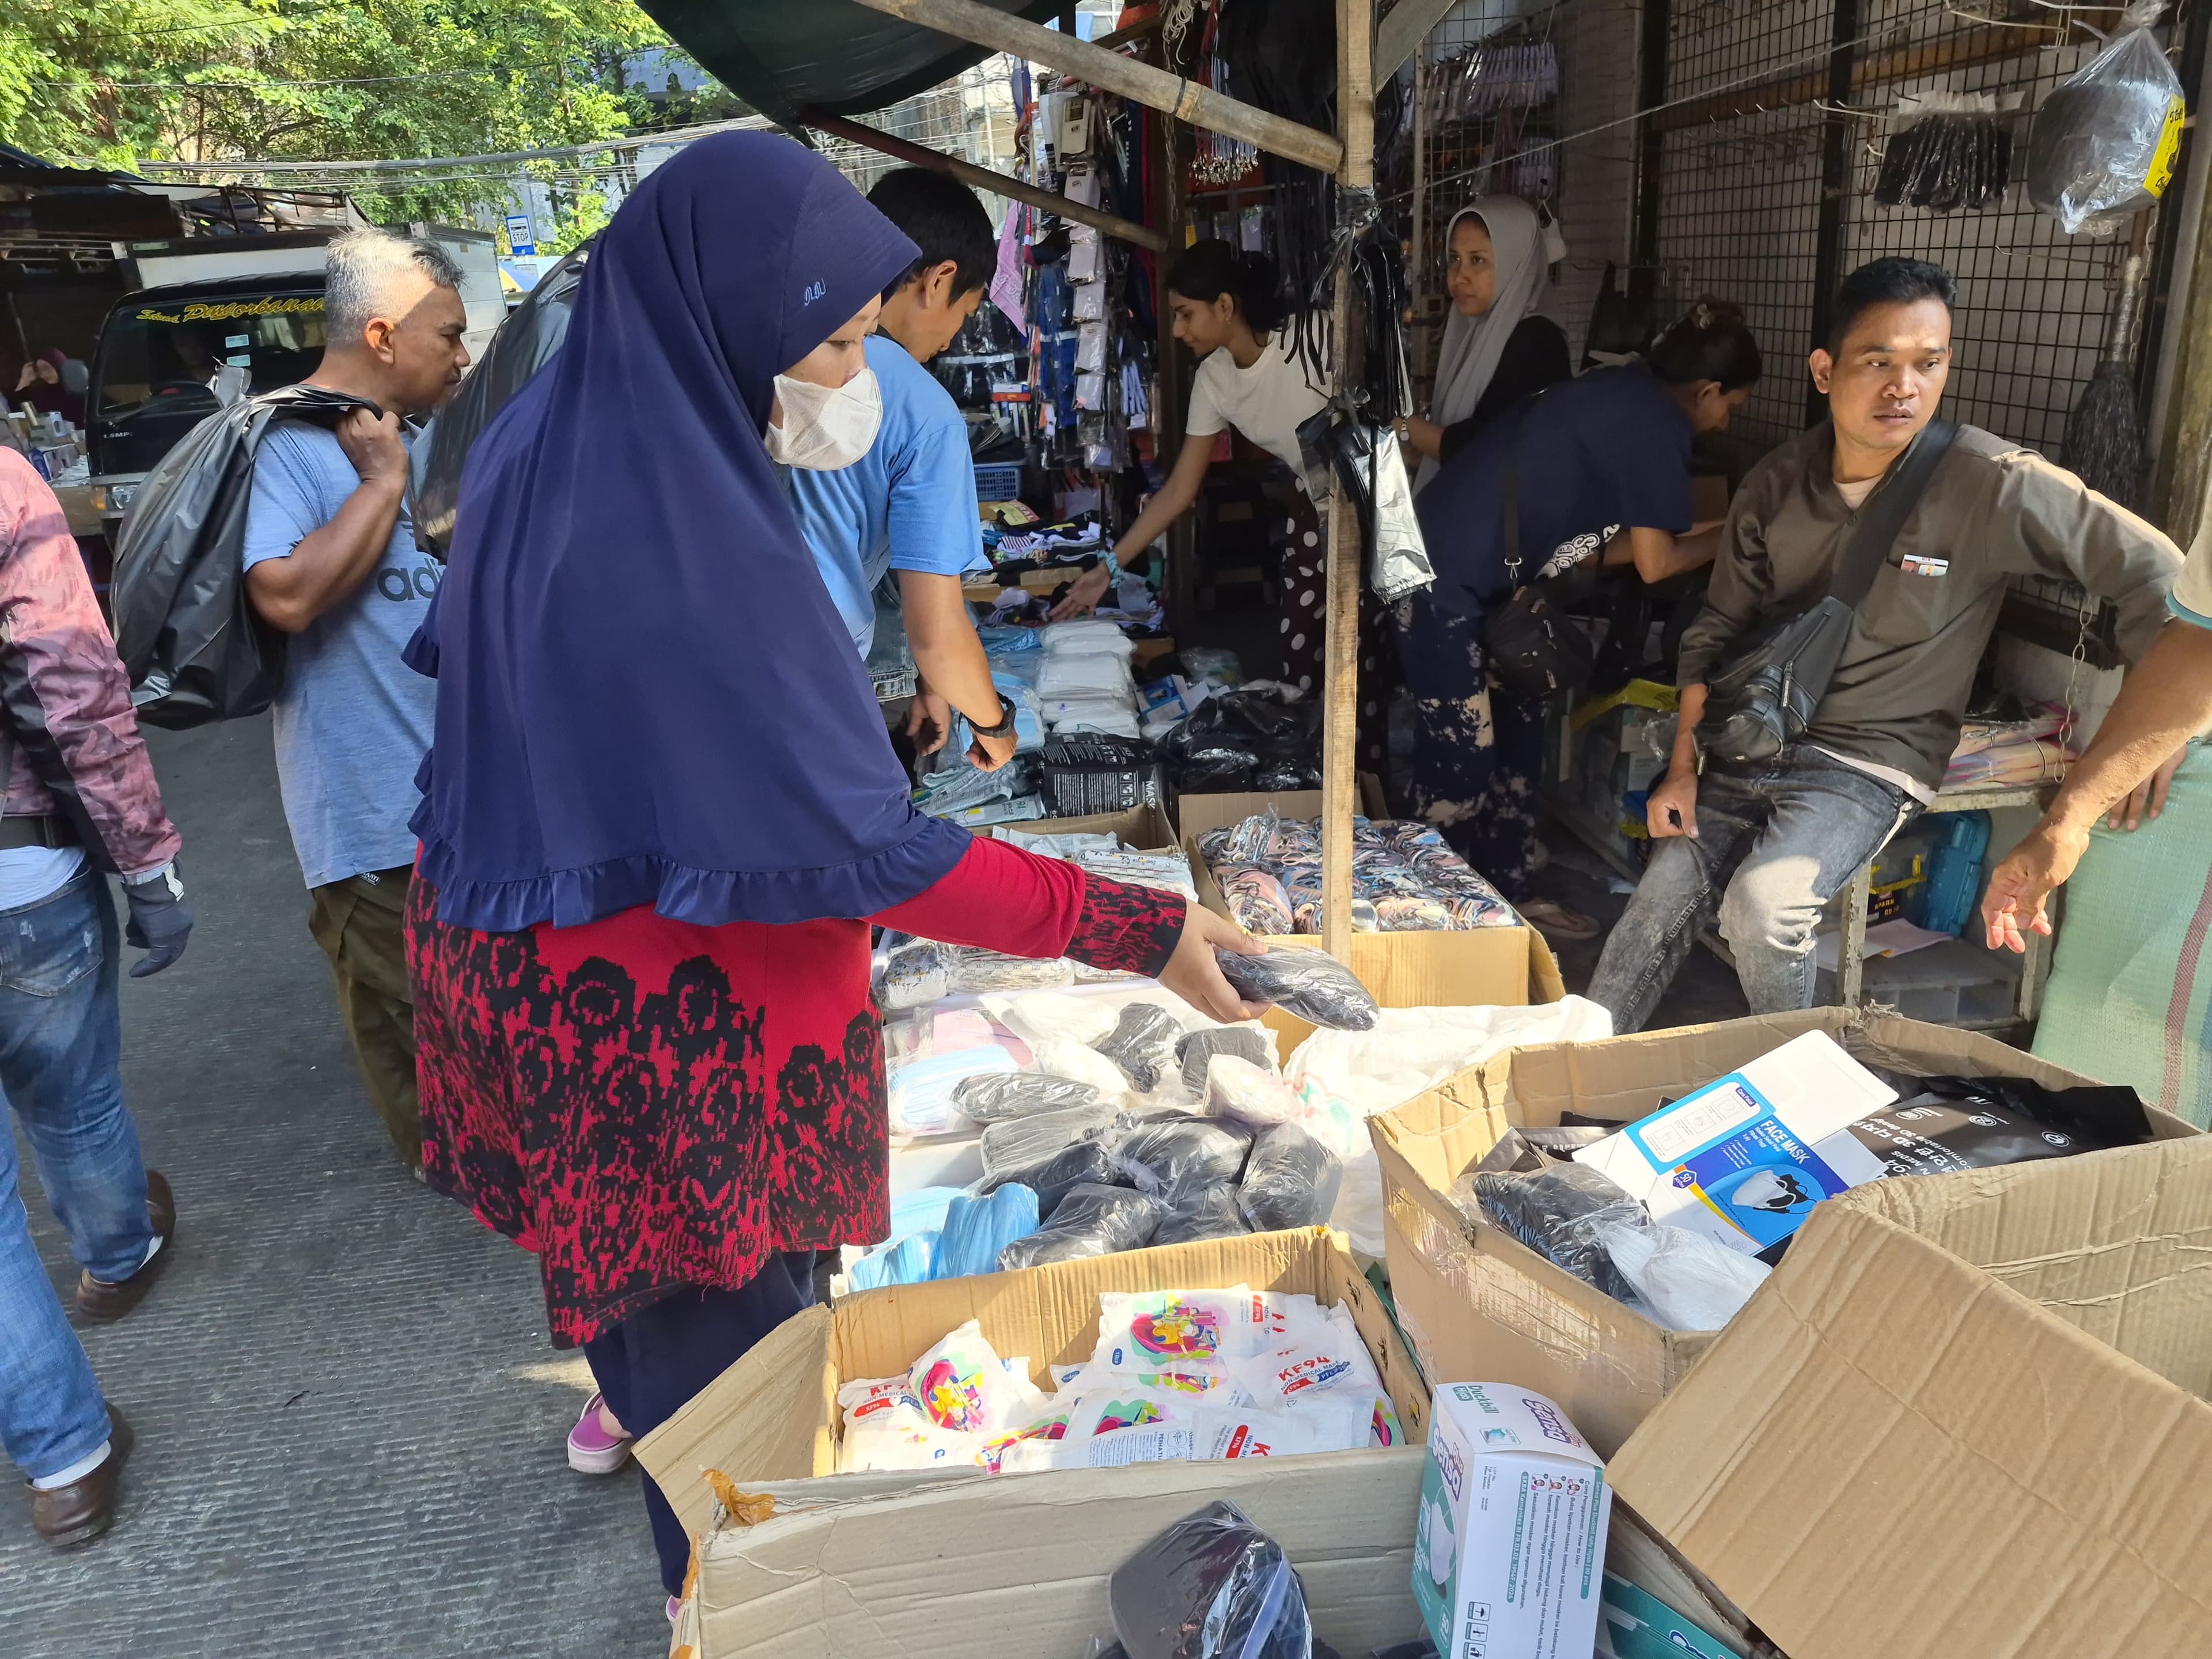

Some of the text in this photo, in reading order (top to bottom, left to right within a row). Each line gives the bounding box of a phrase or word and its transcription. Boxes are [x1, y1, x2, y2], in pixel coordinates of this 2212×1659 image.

[513, 233, 528, 242] STOP
[1760, 1120, 1788, 1144] FACE
[1781, 1139, 1810, 1164] MASK
[1892, 1136, 1916, 1147] 3D
[1899, 1129, 1917, 1141] 3D
[1891, 1150, 1923, 1166] MEDIS
[1679, 1171, 1692, 1184] 50
[1278, 1355, 1331, 1381] KF94
[1281, 1368, 1322, 1392] NON-MEDICAL
[863, 1390, 907, 1404] NON-MEDICAL
[1468, 1385, 1500, 1413] Duckbill
[1522, 1398, 1571, 1444] Sensa
[1232, 1435, 1242, 1449] KF94
[1432, 1423, 1462, 1502] Sensa
